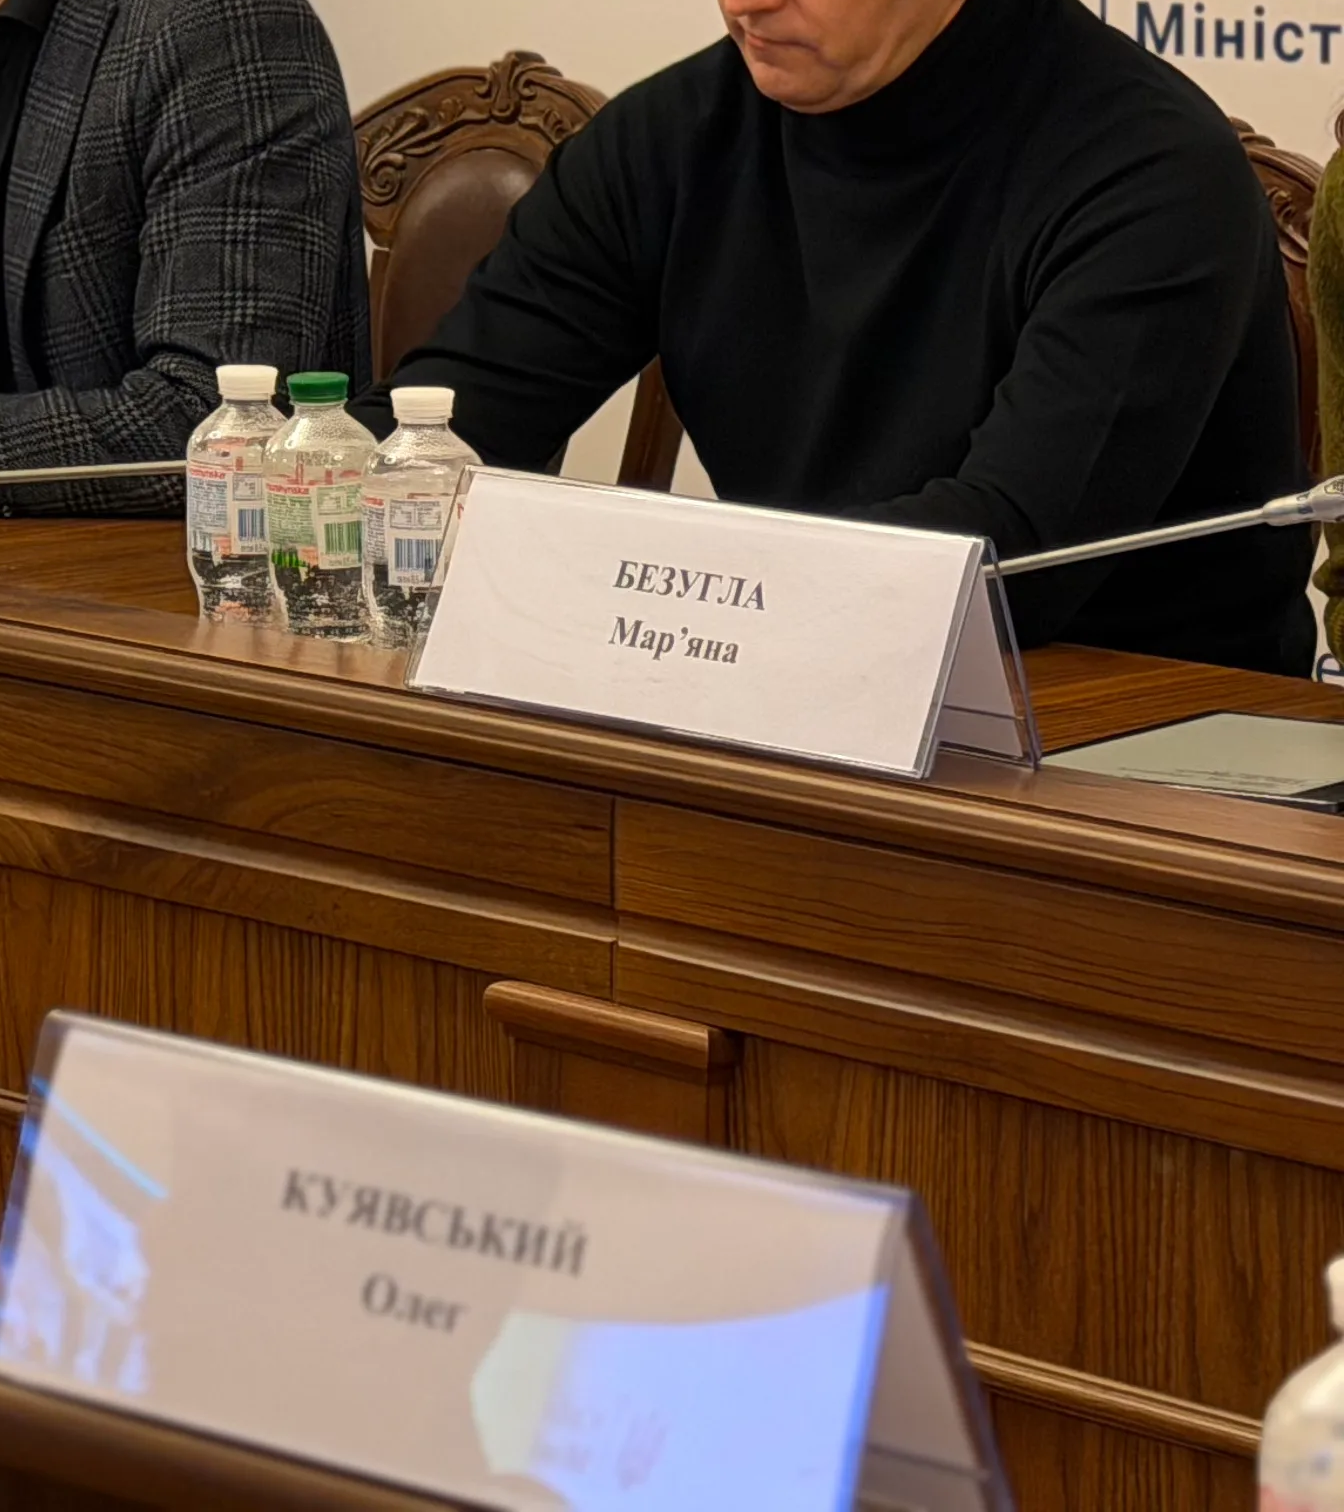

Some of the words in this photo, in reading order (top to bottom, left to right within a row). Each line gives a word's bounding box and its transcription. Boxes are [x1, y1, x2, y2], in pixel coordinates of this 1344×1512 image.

[1136, 1, 1341, 64] Мініст
[613, 560, 766, 610] БЕЗУГЛА
[608, 616, 740, 664] Мар’яна
[281, 1167, 589, 1279] КУЯВСЬКИЙ
[361, 1272, 467, 1333] Олег
